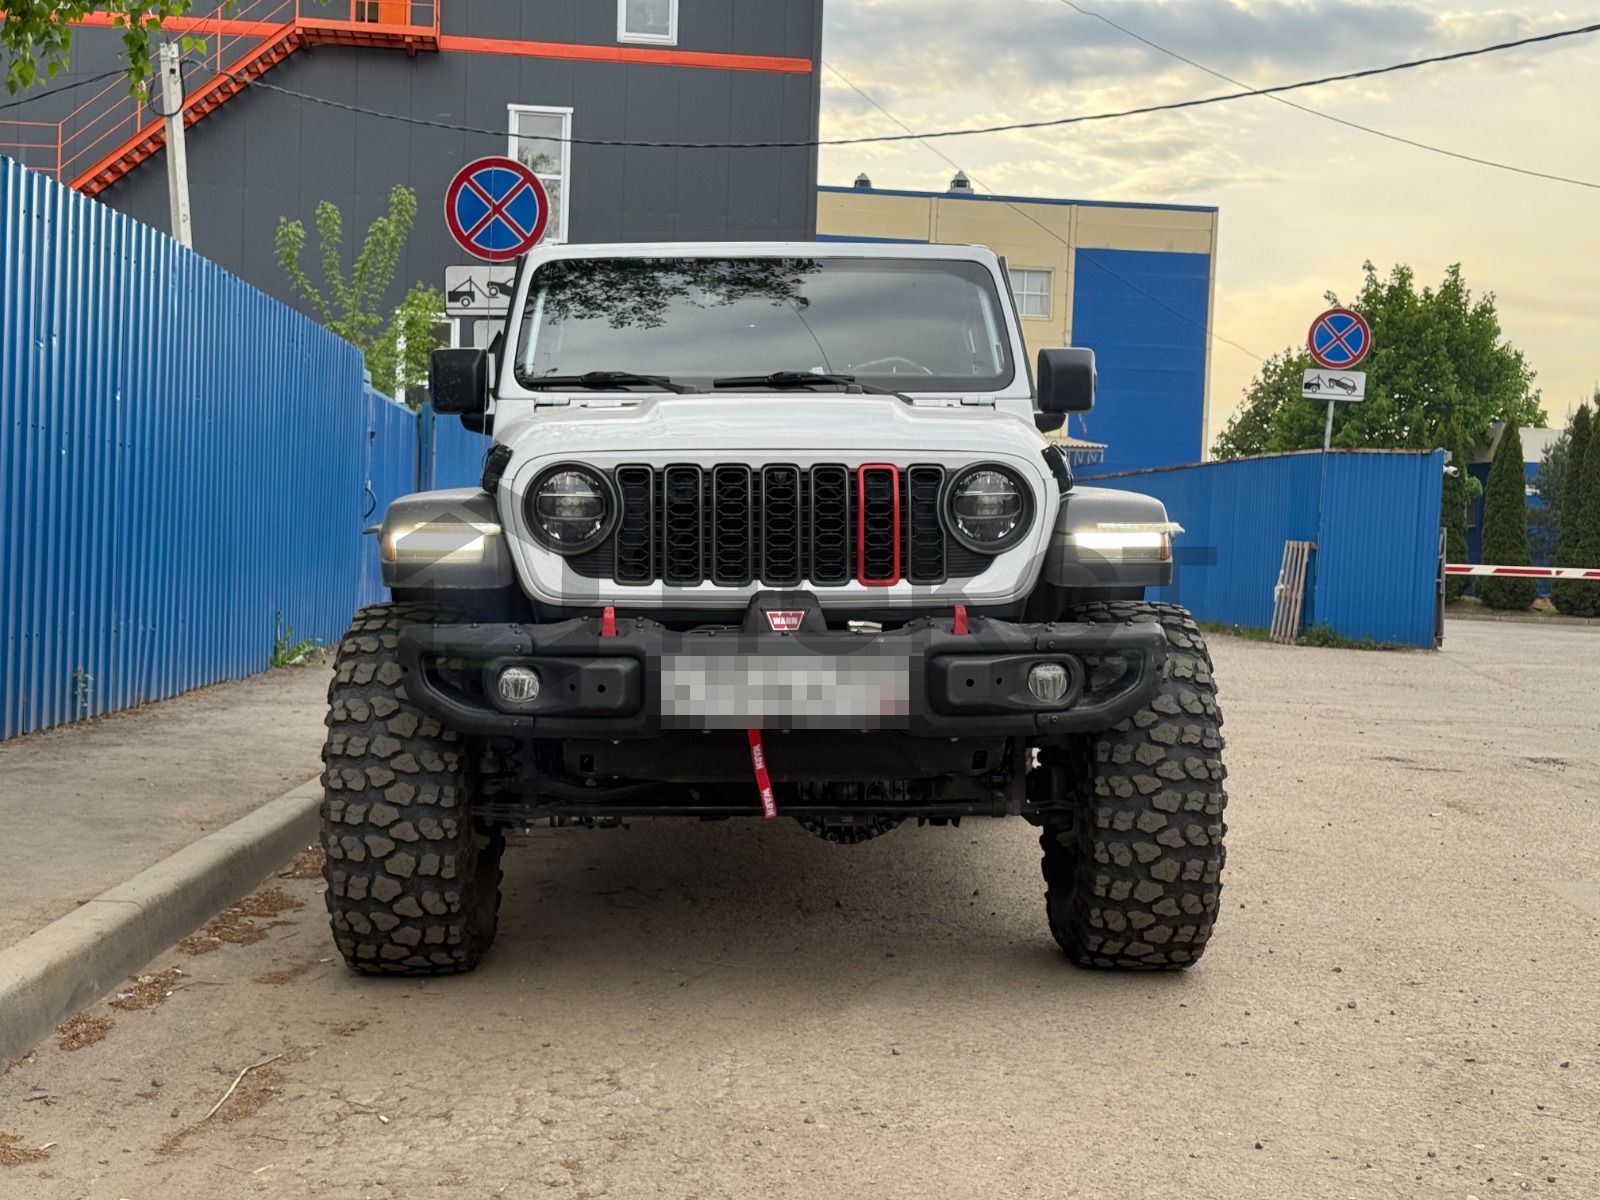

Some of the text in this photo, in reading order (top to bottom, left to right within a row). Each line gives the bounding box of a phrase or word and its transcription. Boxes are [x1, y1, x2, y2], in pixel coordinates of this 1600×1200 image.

[773, 616, 798, 625] WARN
[753, 744, 764, 770] WARN
[762, 787, 775, 816] WARN
